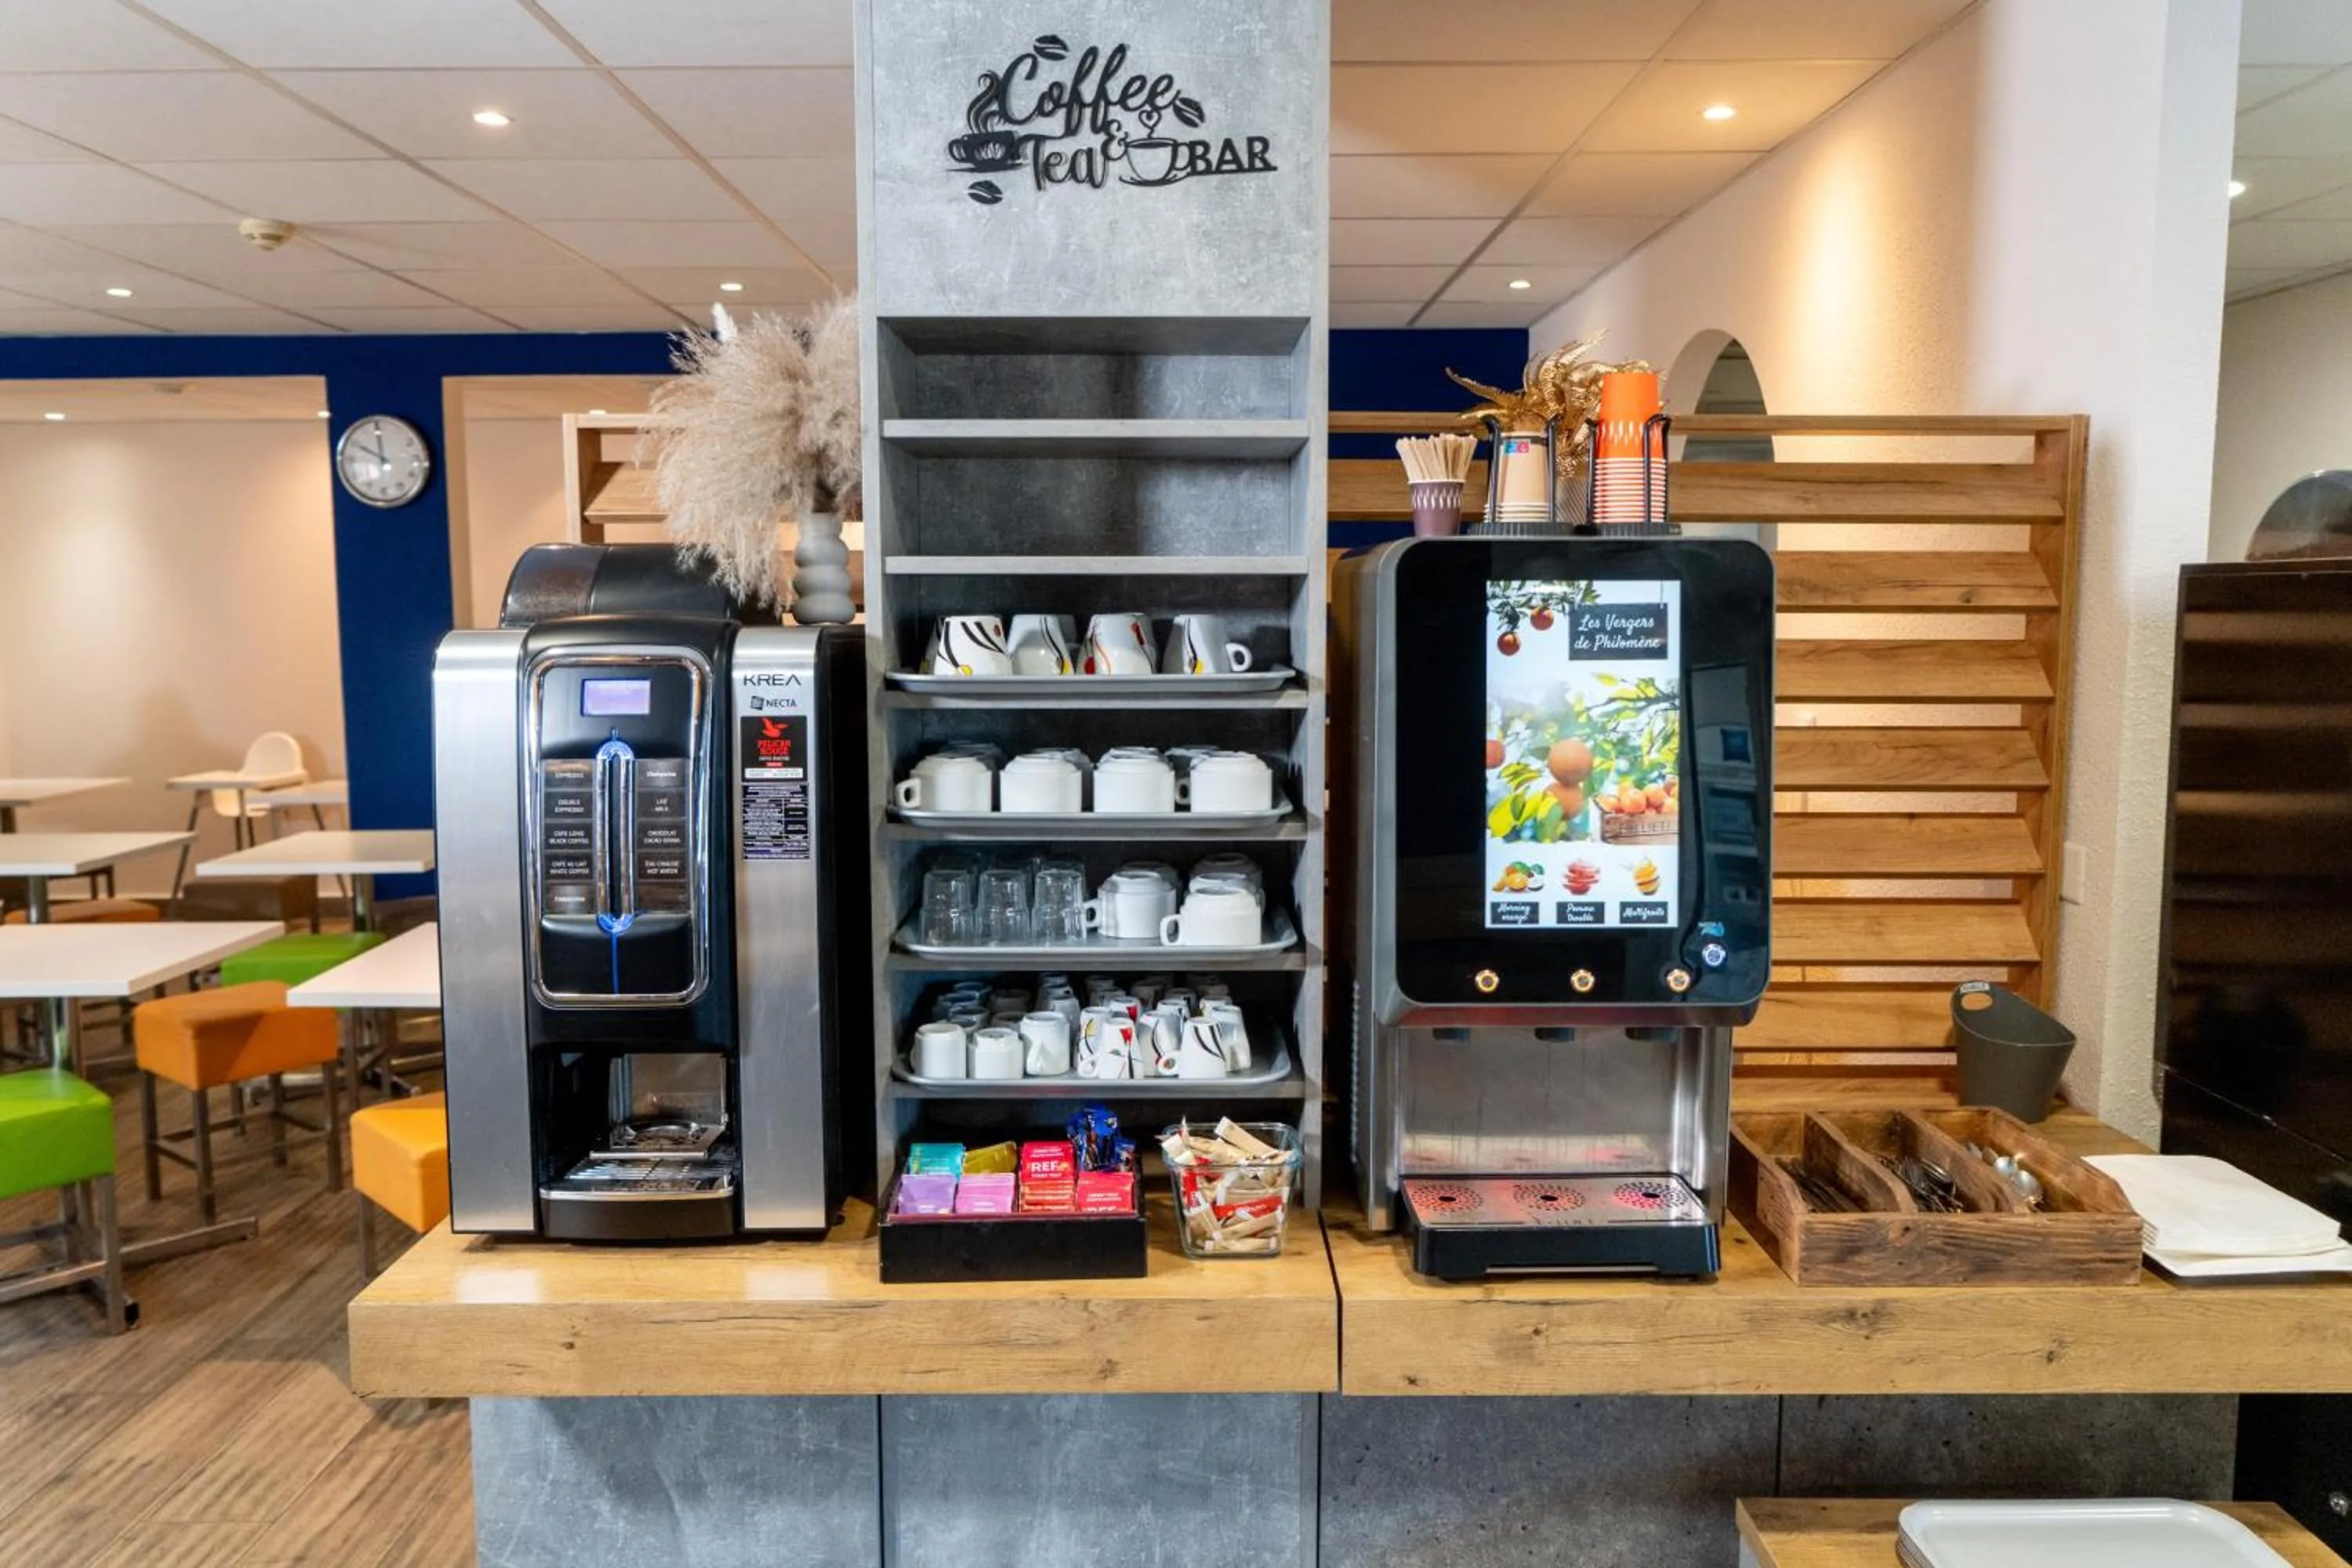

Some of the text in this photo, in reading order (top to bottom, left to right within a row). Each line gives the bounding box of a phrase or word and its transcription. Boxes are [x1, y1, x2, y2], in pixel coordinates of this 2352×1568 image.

[997, 44, 1178, 136] Coffee
[1021, 134, 1105, 191] Tea
[1189, 135, 1278, 176] BAR
[1577, 614, 1654, 636] Les Vergers
[1573, 635, 1592, 649] de
[766, 698, 797, 708] NECTA
